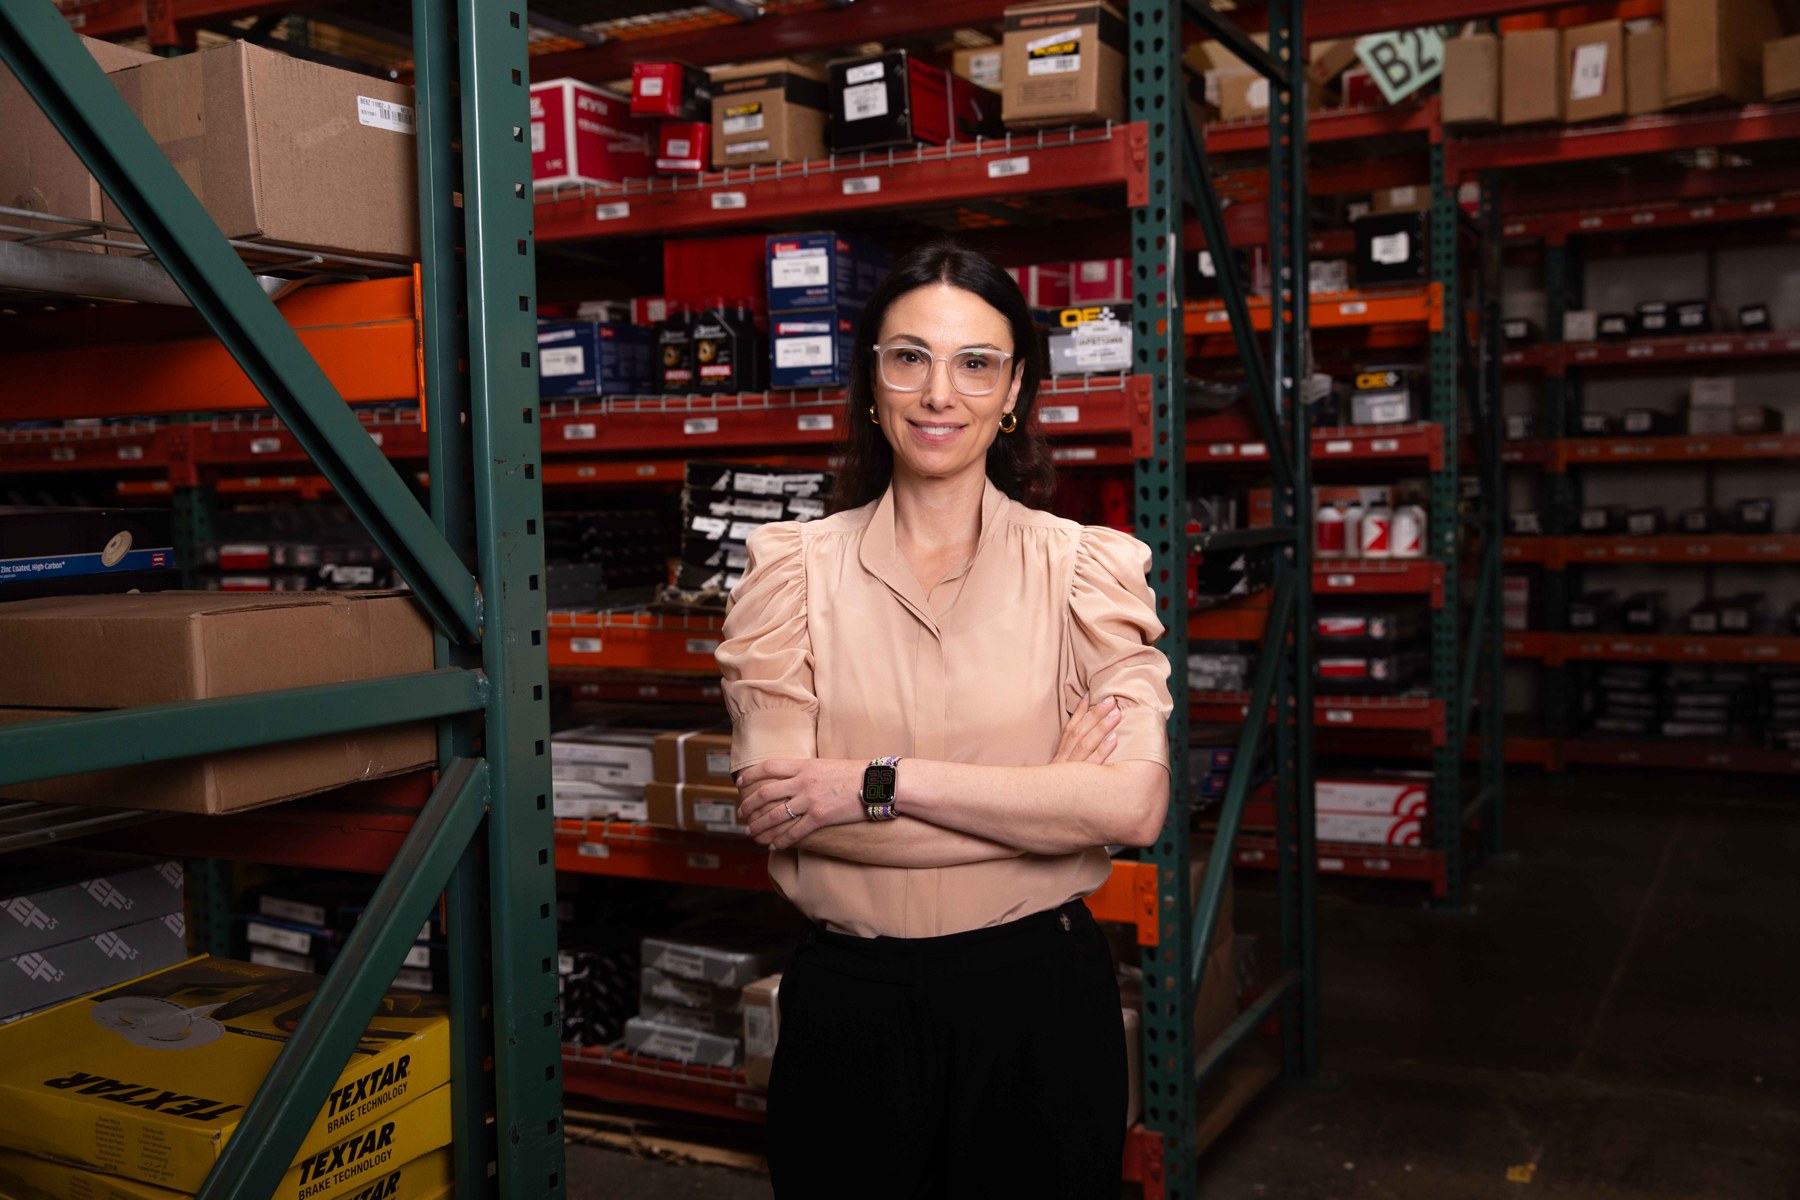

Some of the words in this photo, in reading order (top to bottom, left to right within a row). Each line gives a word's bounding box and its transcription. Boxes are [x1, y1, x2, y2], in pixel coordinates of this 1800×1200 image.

[1369, 28, 1442, 89] B2
[1, 565, 11, 574] Zinc
[12, 563, 31, 573] Coated,
[43, 1072, 246, 1121] TEXTAR
[327, 1110, 356, 1134] BRAKE
[357, 1082, 408, 1117] TECHNOLOGY
[328, 1054, 410, 1118] TEXTAR
[298, 1177, 331, 1200] BRAKE
[333, 1149, 393, 1185] TECHNOLOGY
[299, 1122, 395, 1186] TEXTAR
